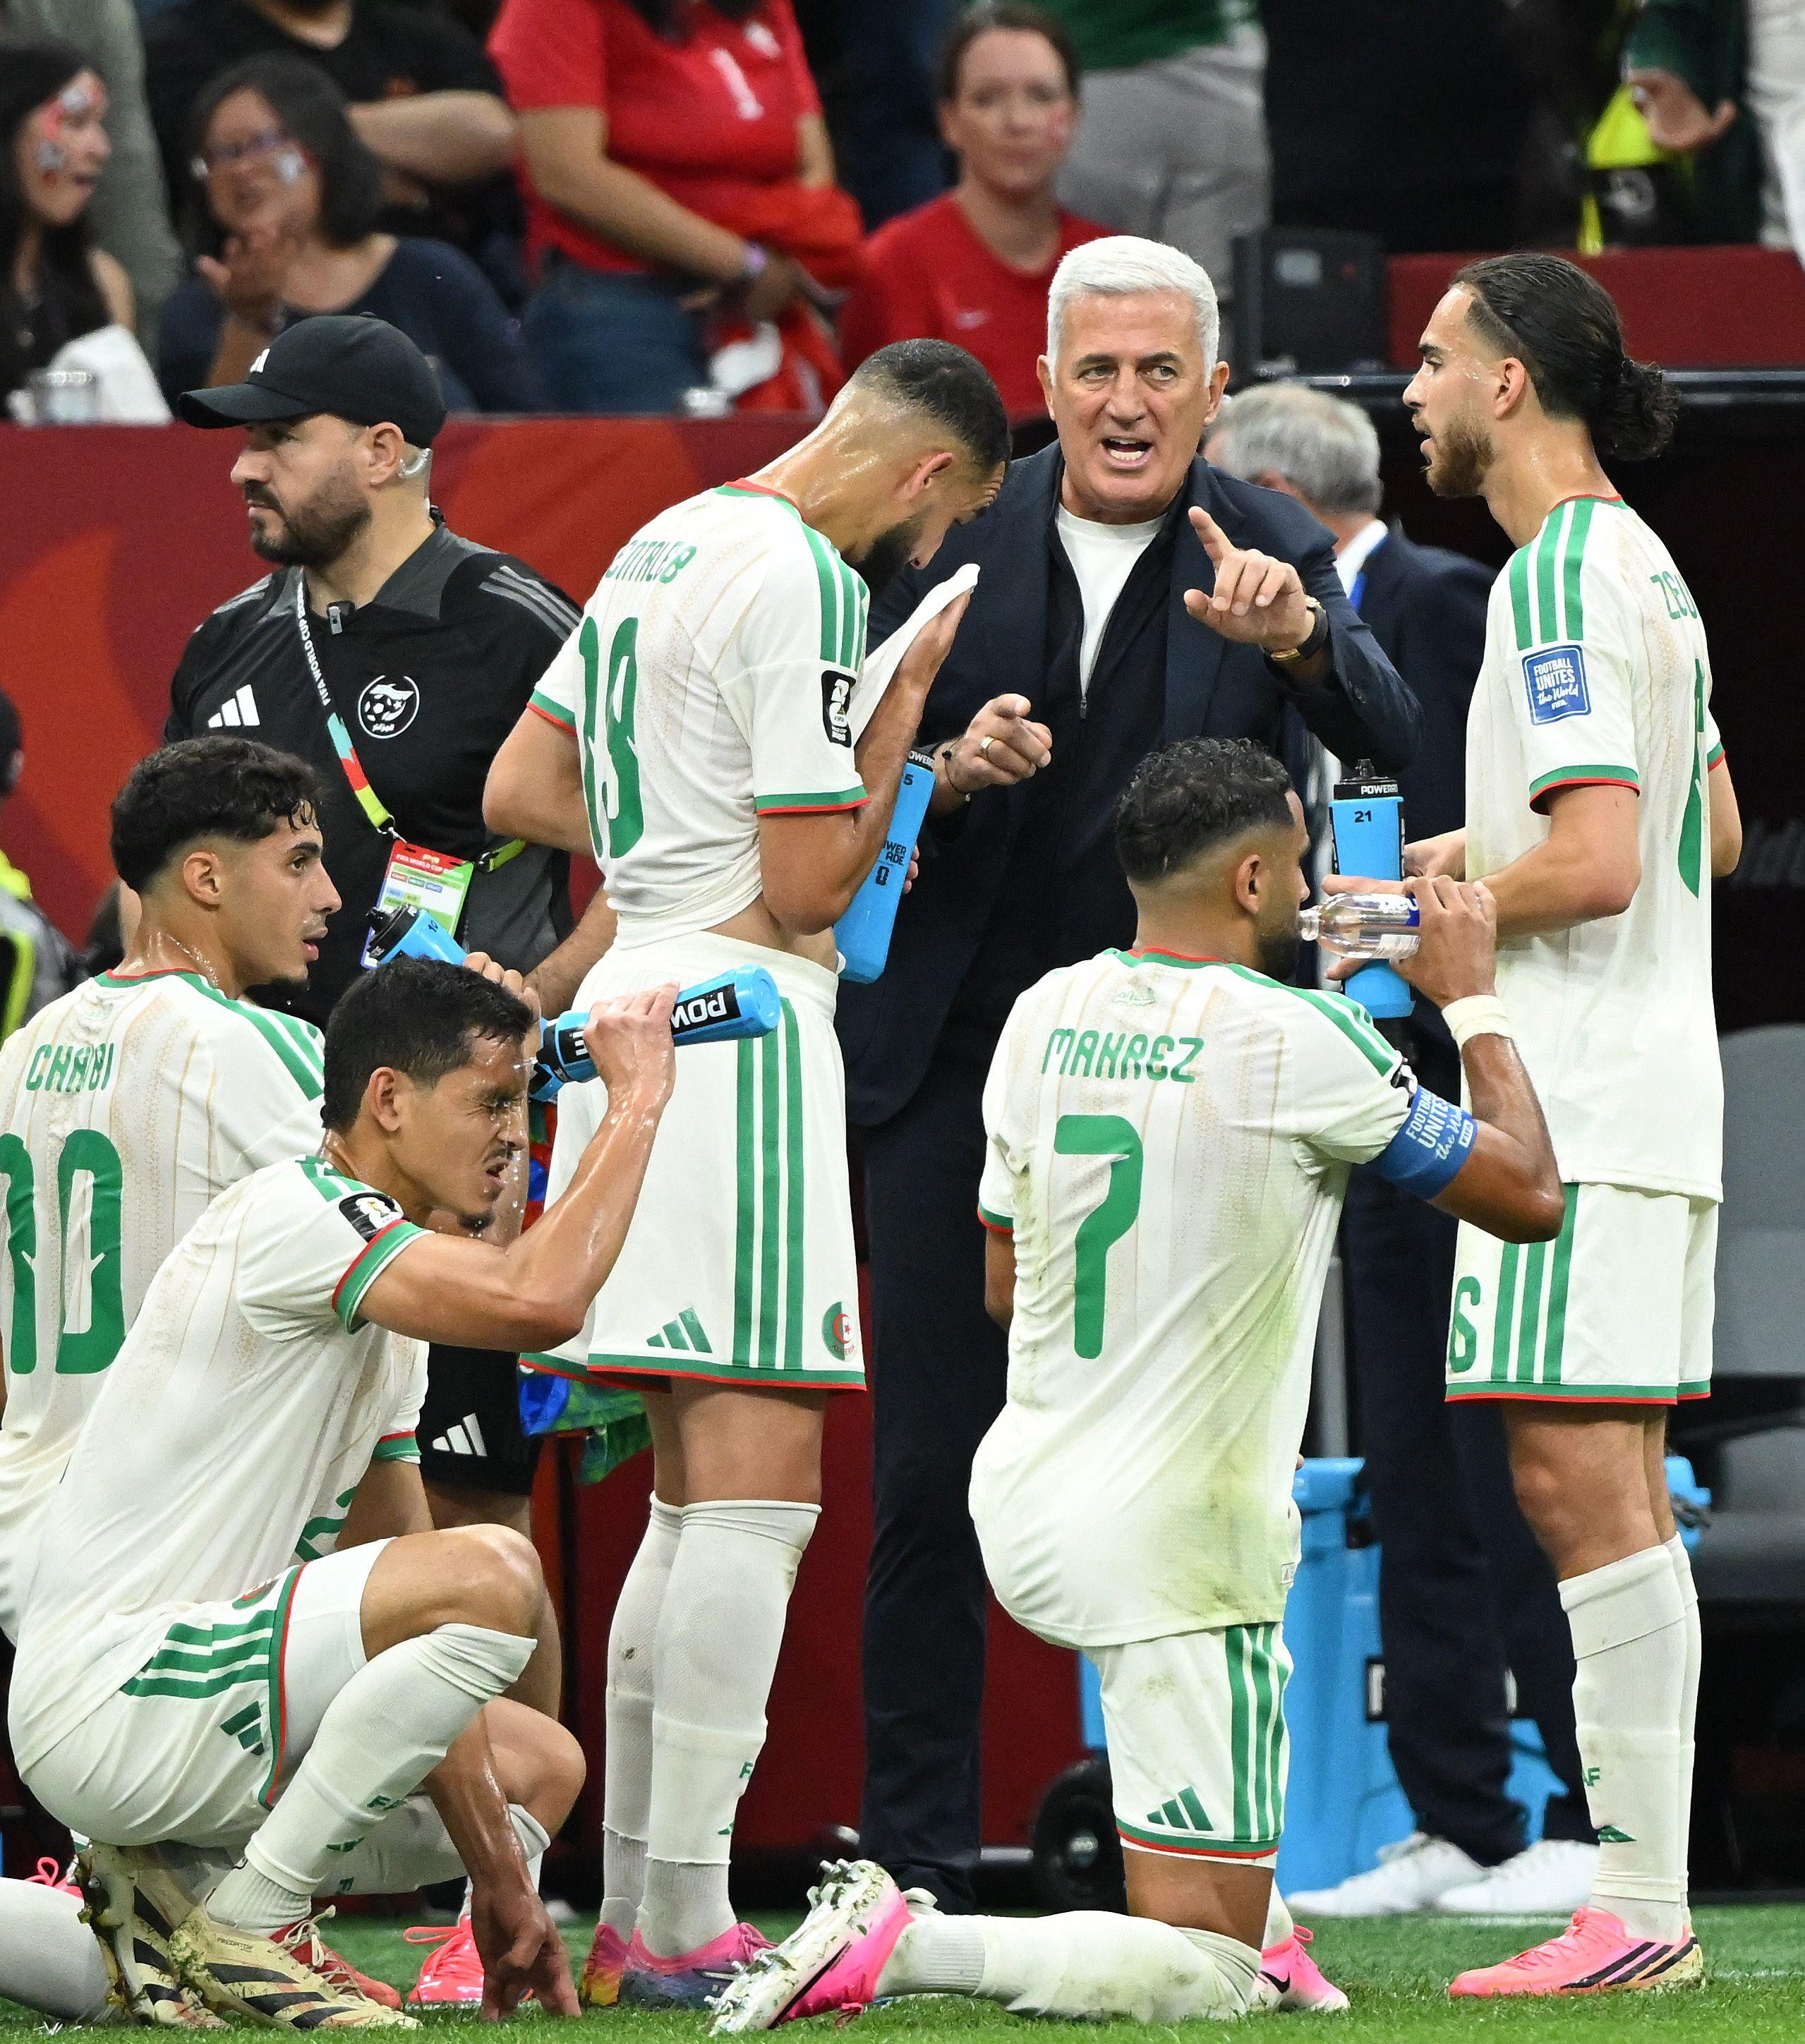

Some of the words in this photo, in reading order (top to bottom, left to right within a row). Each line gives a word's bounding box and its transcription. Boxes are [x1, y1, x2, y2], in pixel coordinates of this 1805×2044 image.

[299, 618, 310, 641] CUP
[304, 639, 322, 682] WORLD
[1533, 657, 1574, 677] FOOTBALL
[1535, 668, 1576, 691] UNITES
[1536, 691, 1552, 706] the
[1552, 683, 1579, 701] World
[579, 616, 646, 859] 19
[908, 750, 934, 767] OWER
[1354, 810, 1372, 823] 21
[1042, 1028, 1205, 1084] MAHREZ
[1054, 1114, 1145, 1360] 7
[1449, 1276, 1481, 1372] 6
